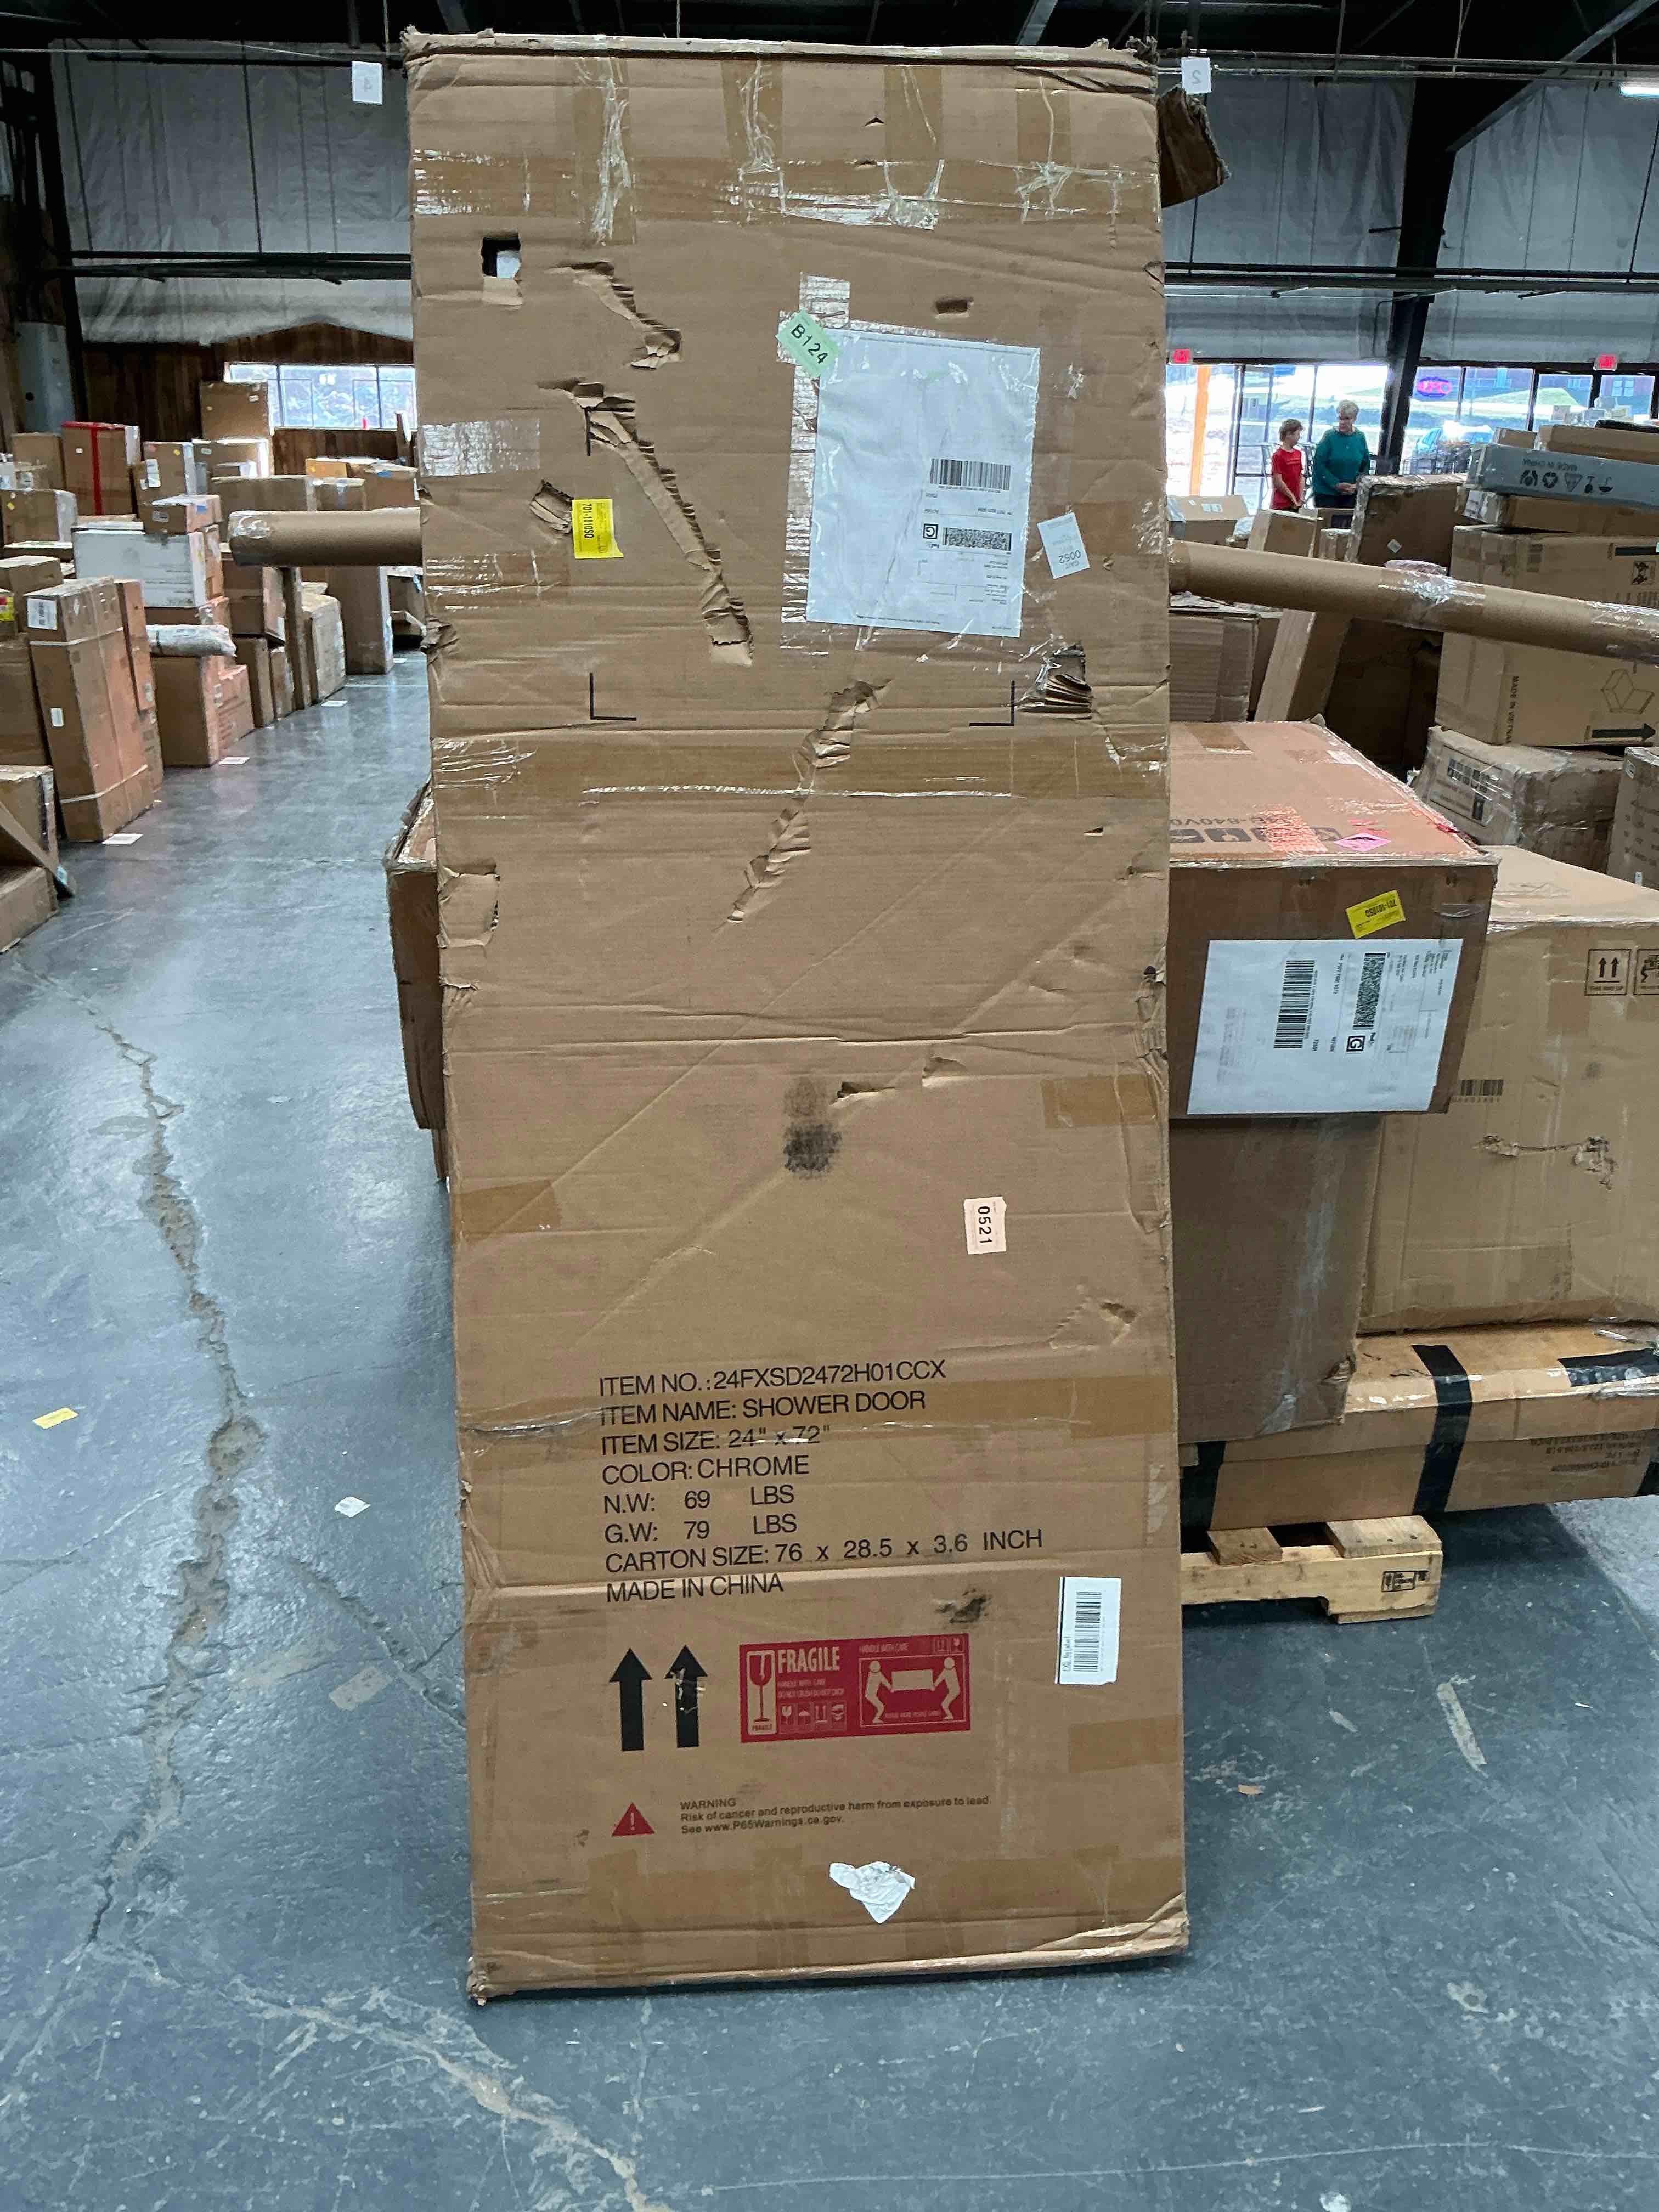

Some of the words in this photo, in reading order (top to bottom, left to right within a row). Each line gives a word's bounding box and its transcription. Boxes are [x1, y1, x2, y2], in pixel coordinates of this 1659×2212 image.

[791, 323, 828, 364] B124
[1057, 550, 1081, 564] 0052
[1509, 675, 1519, 699] MADE
[978, 1206, 992, 1244] 0521
[600, 1375, 655, 1396] ITEM
[601, 1404, 657, 1426] ITEM
[663, 1400, 736, 1422] NAME:
[742, 1393, 849, 1418] SHOWER
[856, 1390, 926, 1412] DOOR
[601, 1434, 658, 1455] ITEM
[663, 1430, 720, 1452] SIZE:
[602, 1461, 693, 1485] COLOR:
[697, 1455, 810, 1479] CHROME
[603, 1493, 655, 1514] N.W:
[684, 1490, 711, 1509] 69
[751, 1484, 795, 1505] LBS
[605, 1522, 658, 1543] G.W:
[684, 1521, 710, 1539] 79
[753, 1513, 797, 1534] LBS
[606, 1548, 707, 1573] CARTON
[713, 1545, 769, 1566] SIZE:
[775, 1543, 803, 1563] 76
[816, 1545, 830, 1560] x
[843, 1538, 893, 1559] 28.5
[906, 1540, 919, 1555] x
[933, 1533, 968, 1553] 3.6
[983, 1528, 1042, 1550] INCH
[607, 1579, 675, 1602] MADE
[682, 1578, 704, 1598] IN
[710, 1573, 784, 1596] CHINA
[777, 1646, 841, 1673] FRAGILE
[680, 1812, 704, 1822] Risk
[706, 1811, 717, 1820] of
[719, 1809, 755, 1819] cancer
[758, 1807, 777, 1816] and
[780, 1801, 845, 1816] reproductive
[848, 1801, 874, 1810] harm
[877, 1799, 901, 1809] from
[904, 1797, 952, 1809] exposure
[953, 1797, 964, 1805] to
[681, 1825, 702, 1835] See
